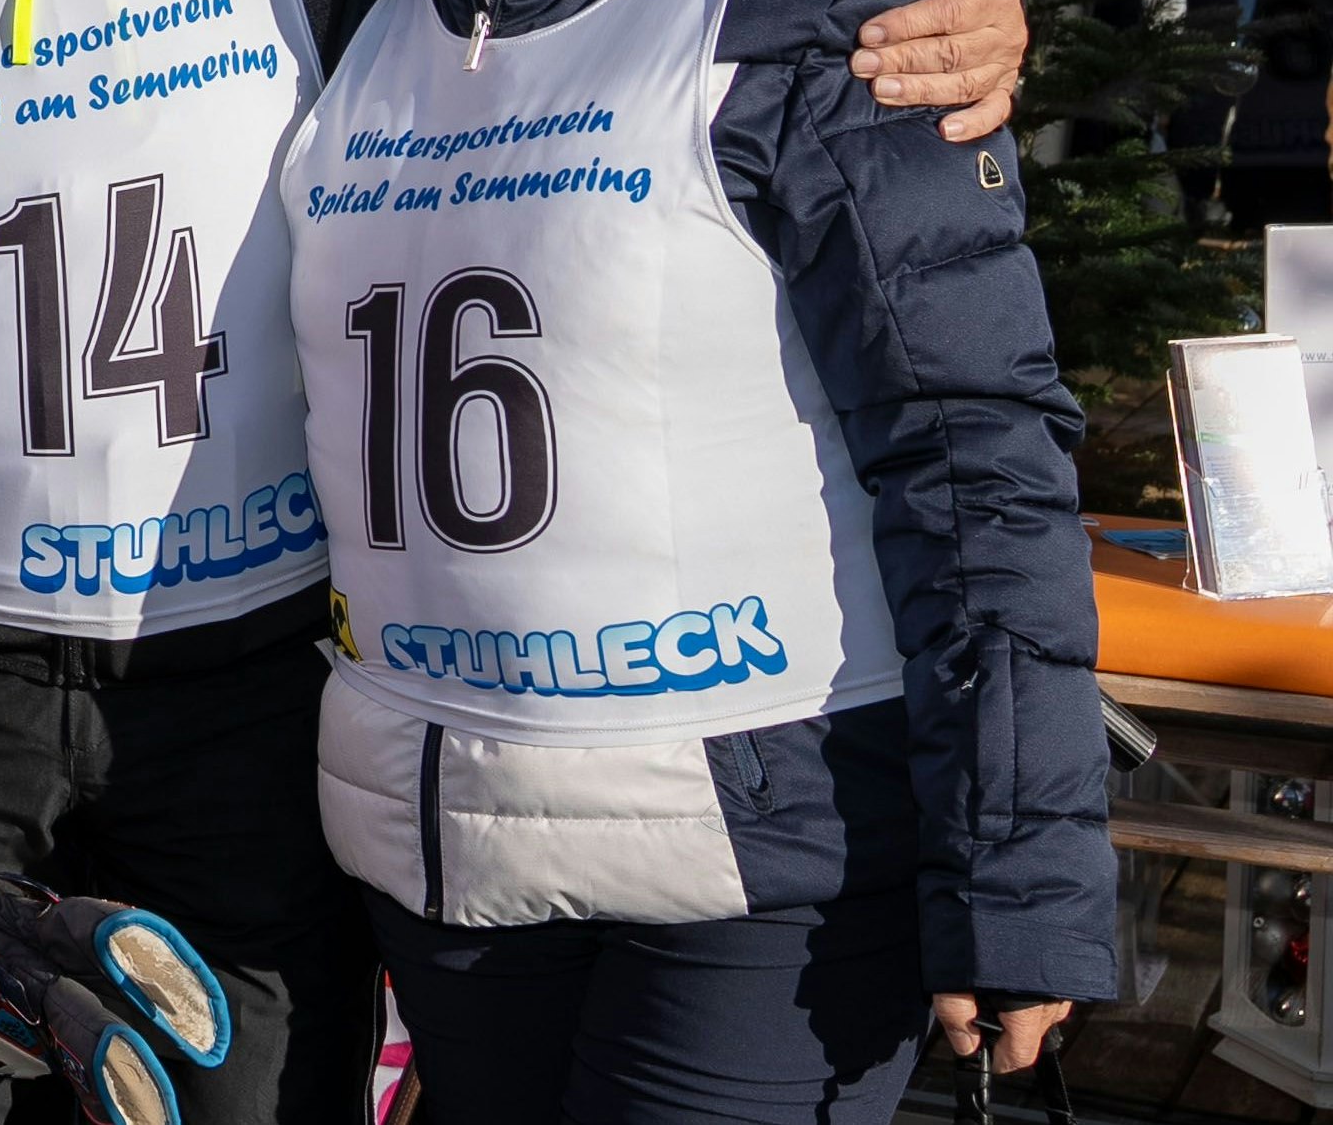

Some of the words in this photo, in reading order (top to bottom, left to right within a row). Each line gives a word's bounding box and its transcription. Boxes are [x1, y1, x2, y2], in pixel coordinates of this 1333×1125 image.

[14, 92, 77, 126] am
[88, 39, 279, 112] Semmering
[345, 101, 614, 163] Wintersportverein
[306, 178, 389, 225] Spital
[393, 185, 443, 213] am
[448, 156, 653, 205] Semmering
[345, 265, 559, 556] 16
[19, 467, 328, 596] STUHLEC
[382, 594, 789, 698] STUHLECK
